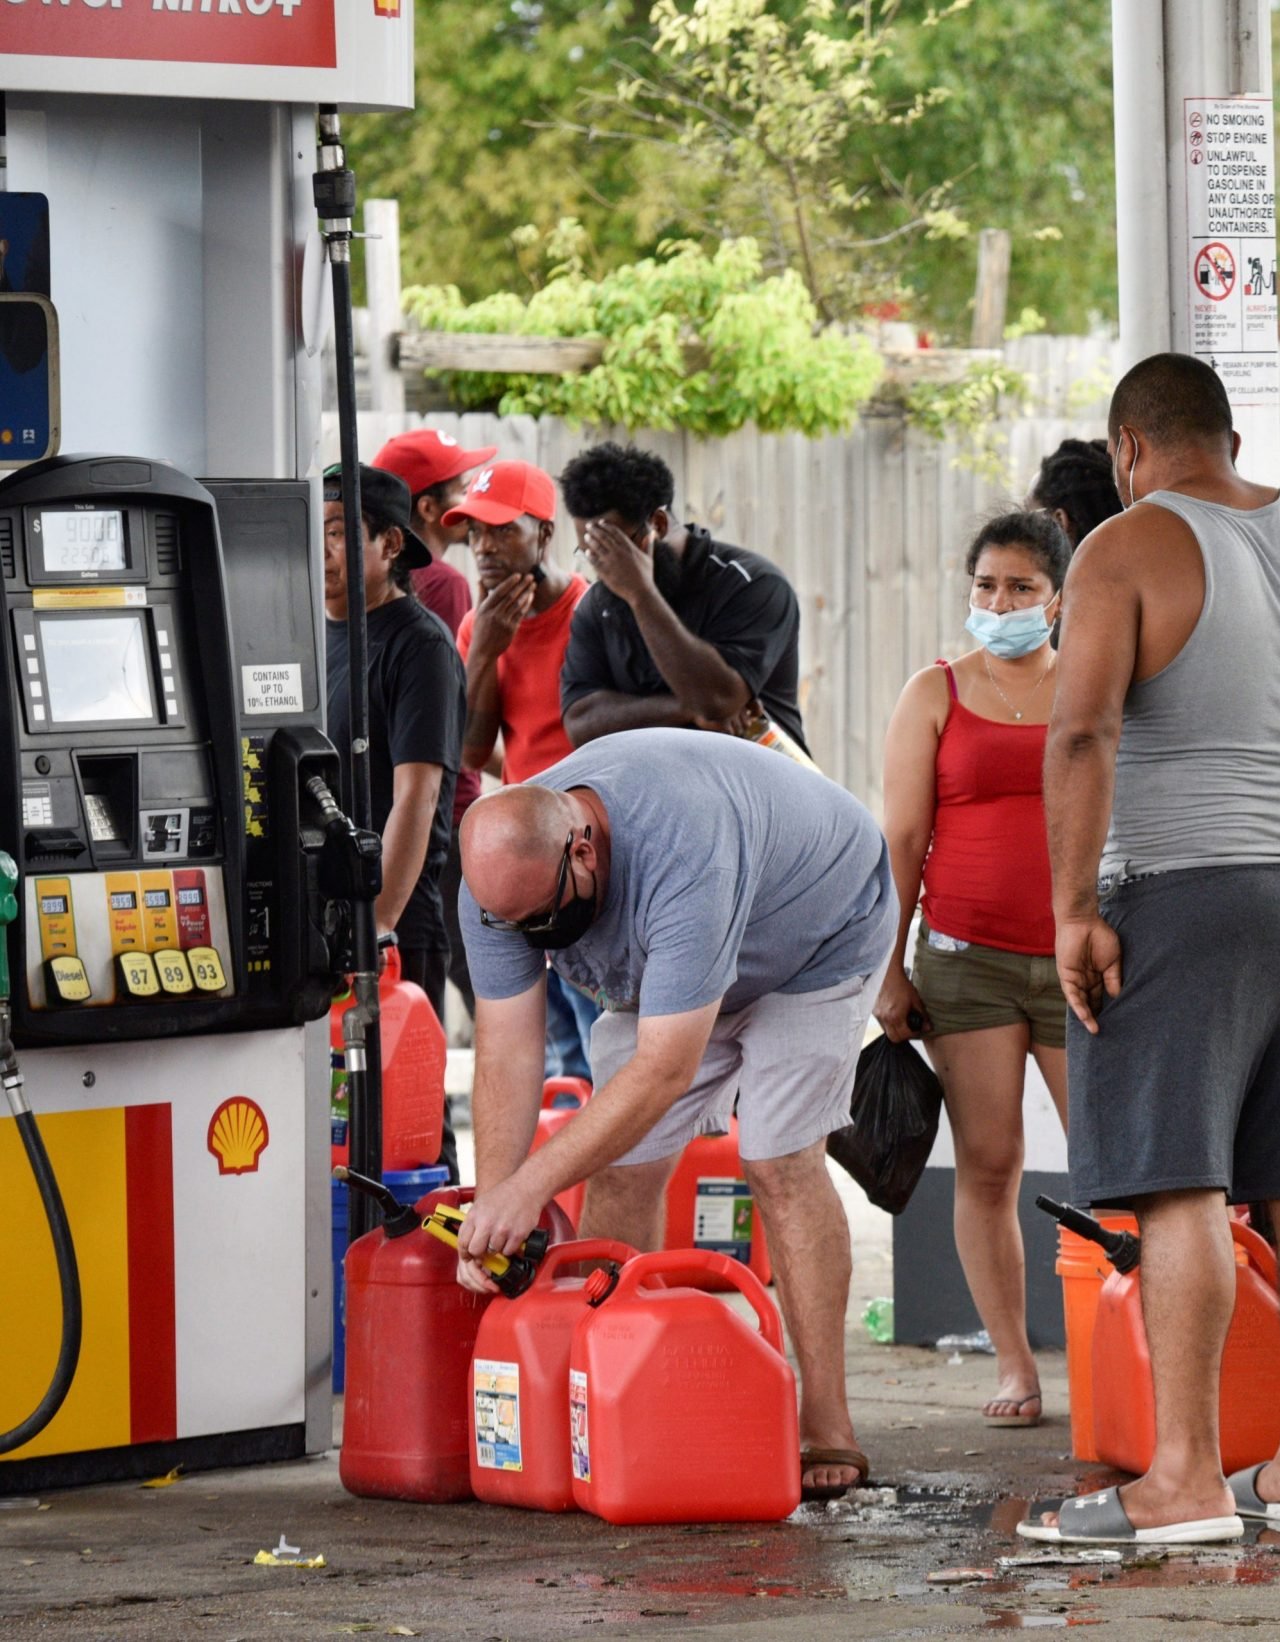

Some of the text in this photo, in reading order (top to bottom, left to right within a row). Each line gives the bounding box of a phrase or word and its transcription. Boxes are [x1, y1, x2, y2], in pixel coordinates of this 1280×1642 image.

[1206, 114, 1265, 126] NO SMOKING
[1206, 132, 1267, 144] STOP ENGINE
[1207, 150, 1257, 162] UNLAWFUL
[1207, 165, 1267, 176] TO DISPENSE
[1208, 179, 1266, 190] GASOLINE IN
[1208, 193, 1226, 205] ANY
[1229, 193, 1261, 205] GLASS
[1208, 207, 1276, 218] UNAUTHORIZE
[1208, 221, 1269, 233] CONTAINERS.
[33, 519, 41, 533] $
[252, 671, 290, 681] CONTAINS
[261, 684, 283, 694] UP TO
[247, 696, 299, 707] 10% ETHANOL
[56, 969, 84, 981] Diesel
[130, 969, 148, 985] 87
[164, 967, 184, 982] 89
[198, 964, 217, 980] 93
